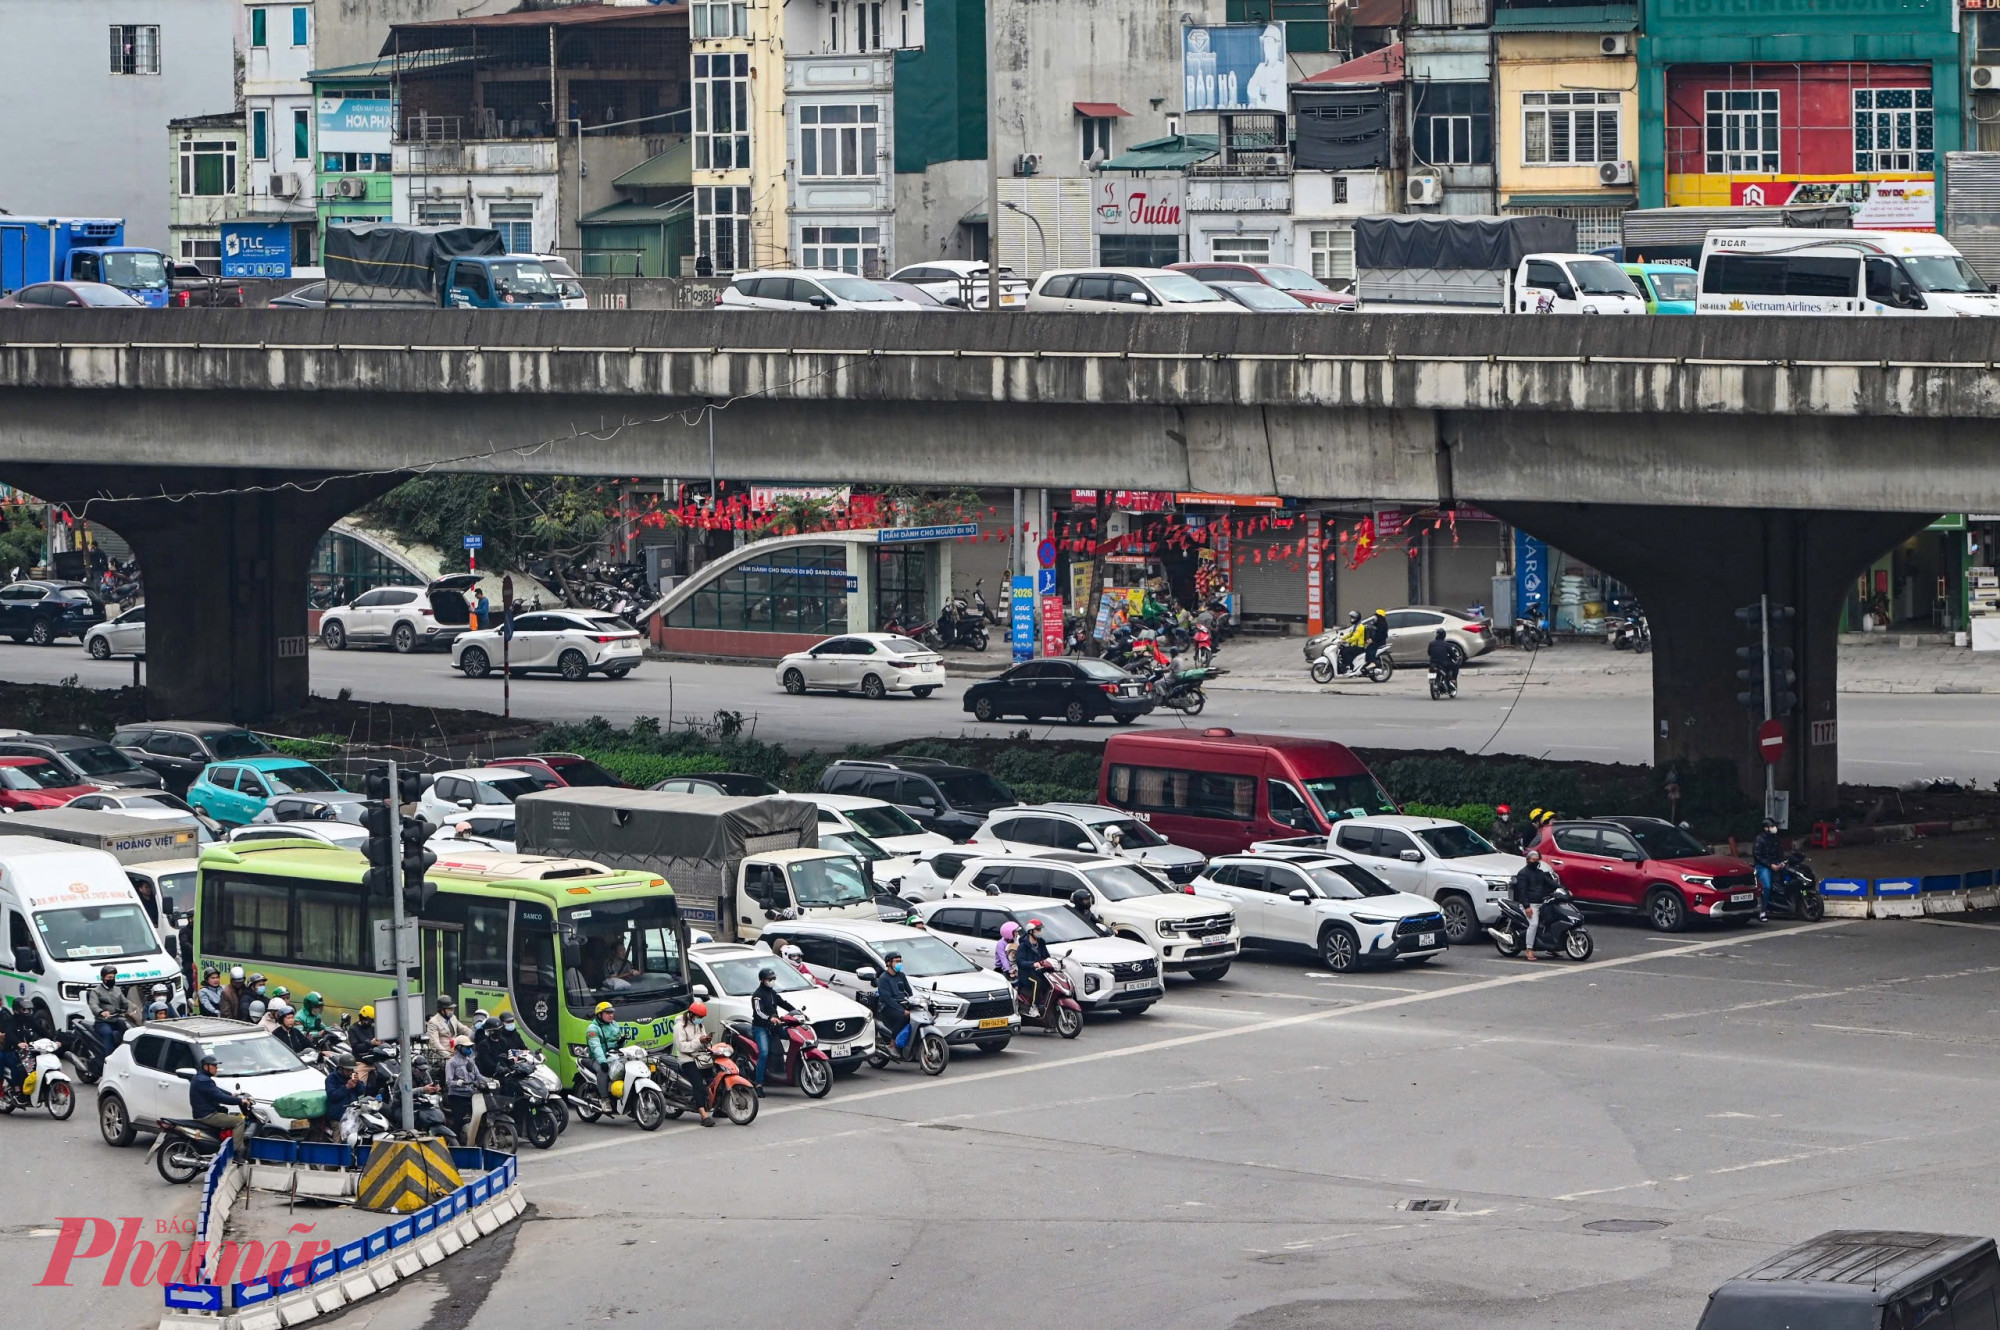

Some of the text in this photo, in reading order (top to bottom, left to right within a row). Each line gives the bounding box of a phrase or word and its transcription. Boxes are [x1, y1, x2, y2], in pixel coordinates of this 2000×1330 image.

[1128, 192, 1181, 224] Tuấn
[241, 237, 263, 248] TLC
[1745, 301, 1822, 312] Vietnam Airlines
[1013, 588, 1032, 598] 2026
[116, 834, 173, 851] HOÀNG VIỆT
[523, 912, 542, 920] SAMCO
